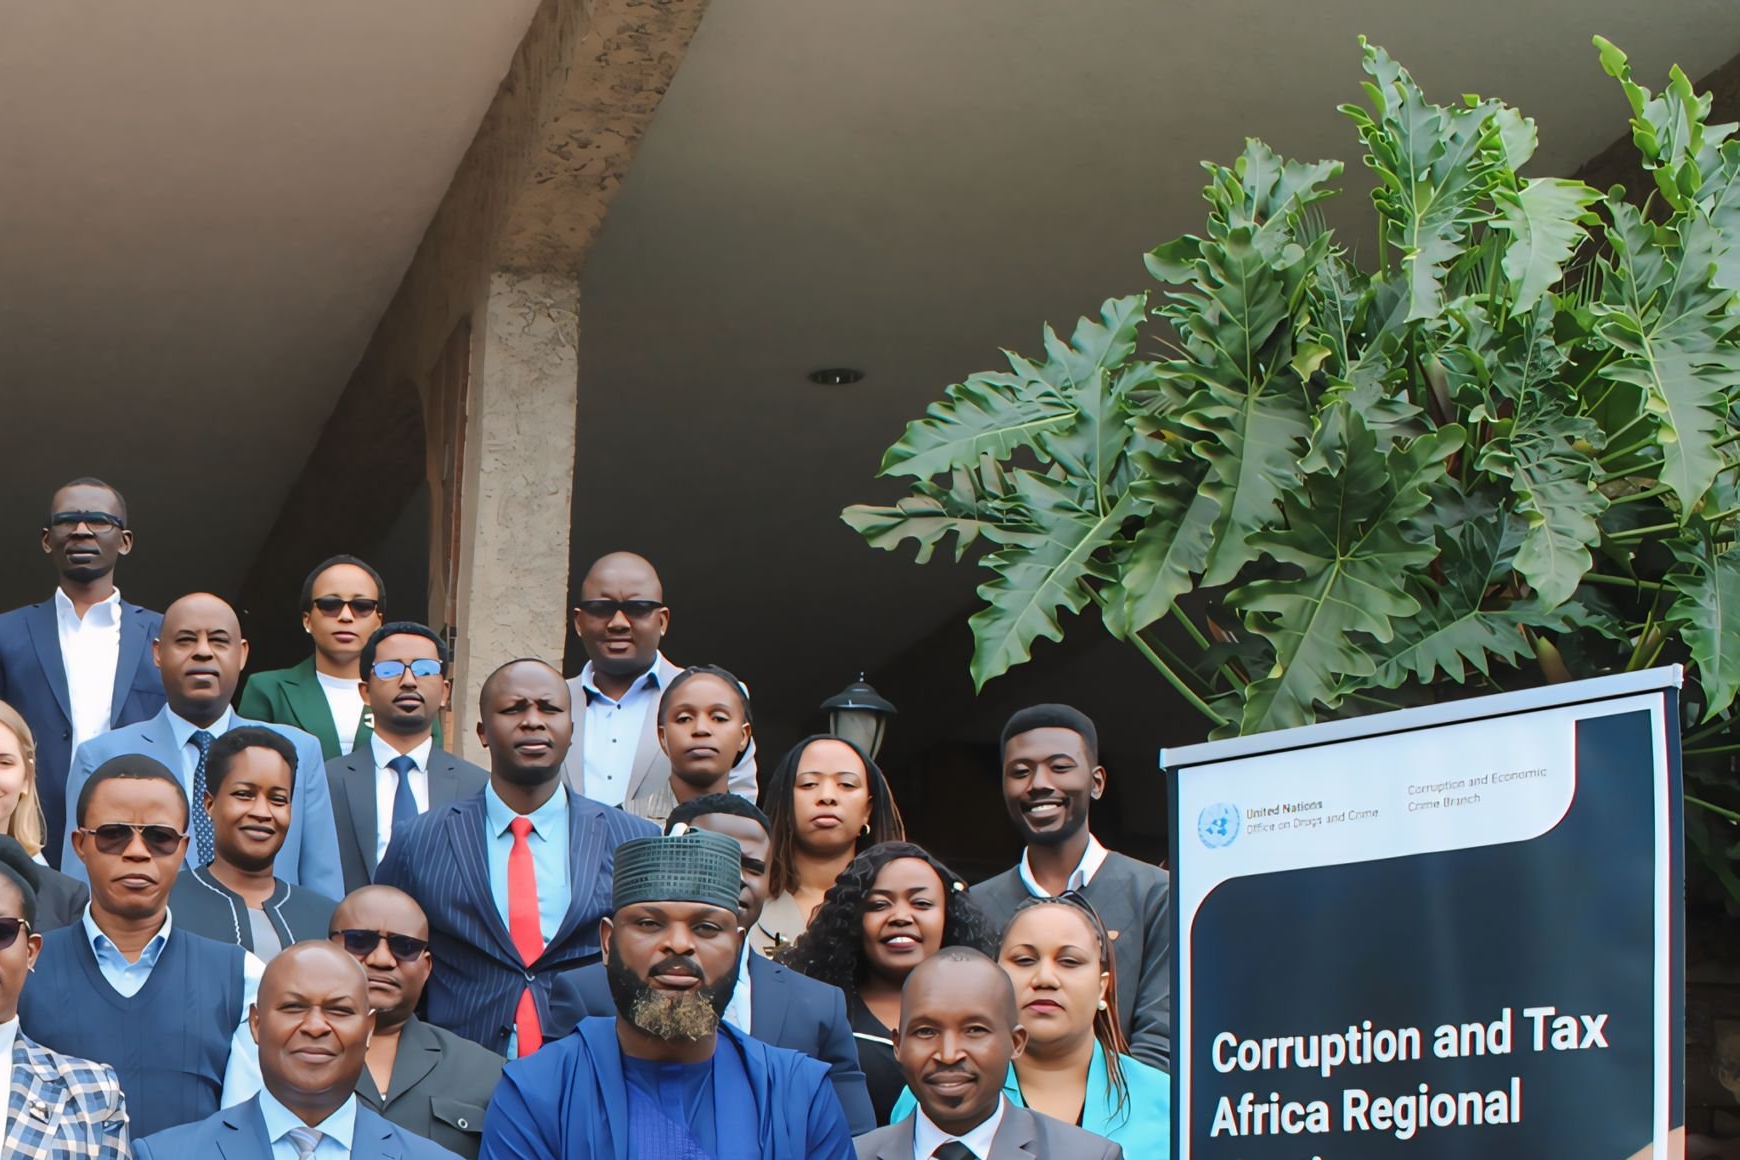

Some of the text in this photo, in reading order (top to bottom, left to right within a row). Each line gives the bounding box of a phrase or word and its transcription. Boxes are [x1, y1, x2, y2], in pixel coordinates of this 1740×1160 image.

[1407, 768, 1547, 795] Corruption and Economic
[1246, 800, 1323, 820] United Nations
[1211, 1006, 1609, 1078] Corruption and Tax
[1210, 1077, 1522, 1140] Africa Regional
